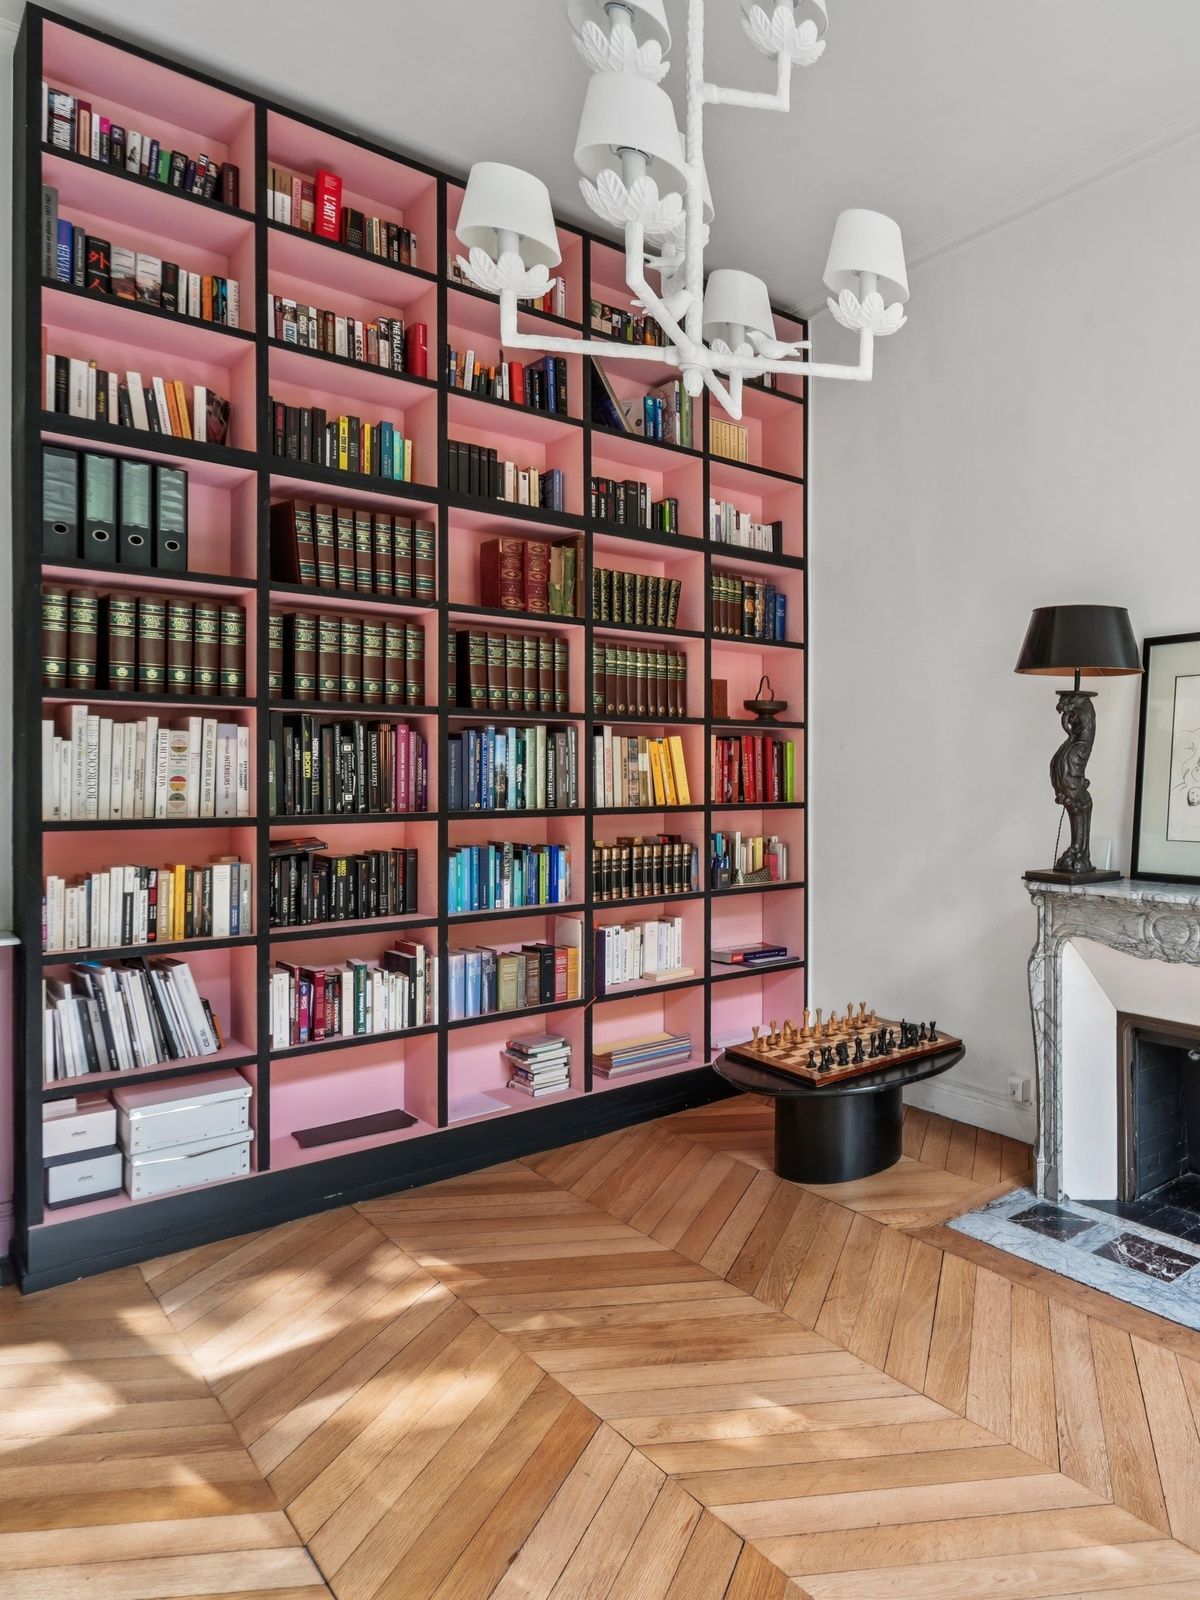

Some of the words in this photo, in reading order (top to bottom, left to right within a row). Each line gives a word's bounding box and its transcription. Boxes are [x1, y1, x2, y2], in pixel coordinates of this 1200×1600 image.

[323, 194, 337, 223] L'ART
[392, 321, 401, 335] THE
[393, 335, 402, 363] PALACE
[206, 739, 214, 749] AU
[205, 749, 214, 769] CLAIR
[87, 741, 98, 799] BOURGOGNE
[205, 769, 213, 778] DE
[223, 755, 231, 786] INTÉRIEURS
[205, 778, 213, 787] LA
[205, 787, 213, 802] MER
